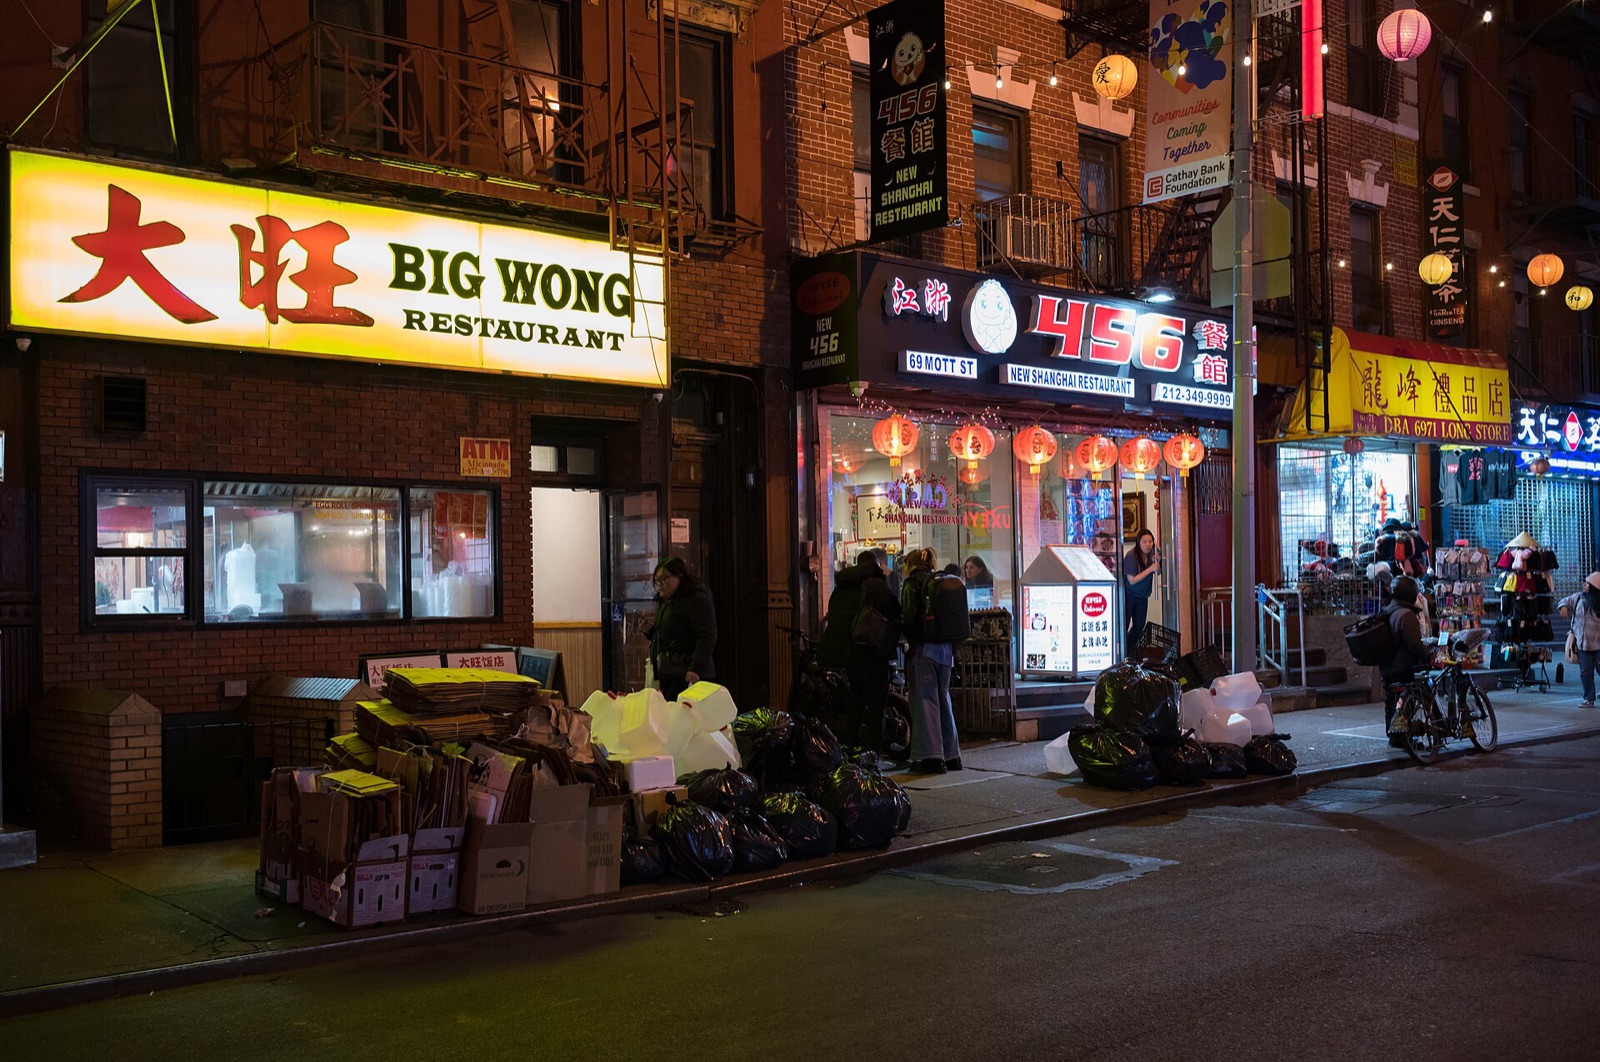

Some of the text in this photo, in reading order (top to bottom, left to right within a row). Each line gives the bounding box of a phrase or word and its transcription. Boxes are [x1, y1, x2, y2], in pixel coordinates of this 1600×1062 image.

[877, 82, 938, 126] 456
[1152, 99, 1221, 125] Communities
[880, 116, 935, 164] 餐館
[1167, 122, 1207, 140] Coming
[1163, 140, 1211, 163] Together
[895, 164, 917, 184] NEW
[1165, 161, 1225, 184] Cathay Bank
[881, 180, 933, 207] SHANGHAI
[1165, 176, 1217, 194] Foundation
[875, 196, 943, 227] RESTAURANT
[57, 183, 375, 325] 大旺
[387, 242, 634, 318] BIG WONG
[892, 277, 951, 322] 江浙
[1452, 307, 1465, 315] TEA
[402, 308, 625, 352] RESTAURANT
[815, 317, 832, 333] NEW
[1033, 295, 1186, 372] 456
[809, 332, 839, 356] 456
[1199, 320, 1229, 385] 餐館
[909, 355, 974, 376] 69 MOTT ST
[1010, 367, 1132, 395] NEW SHANGHAI RESTAURANT
[1362, 359, 1503, 417] 龍峰禮品店
[1162, 387, 1231, 407] 212-349-9999
[1384, 416, 1509, 441] DBA 6971 LONG STORE
[463, 439, 508, 460] ATM
[467, 459, 505, 468] Aficionado
[884, 514, 963, 525] SHANGHAI RESTAURANT
[459, 656, 504, 669] 大旺饭店
